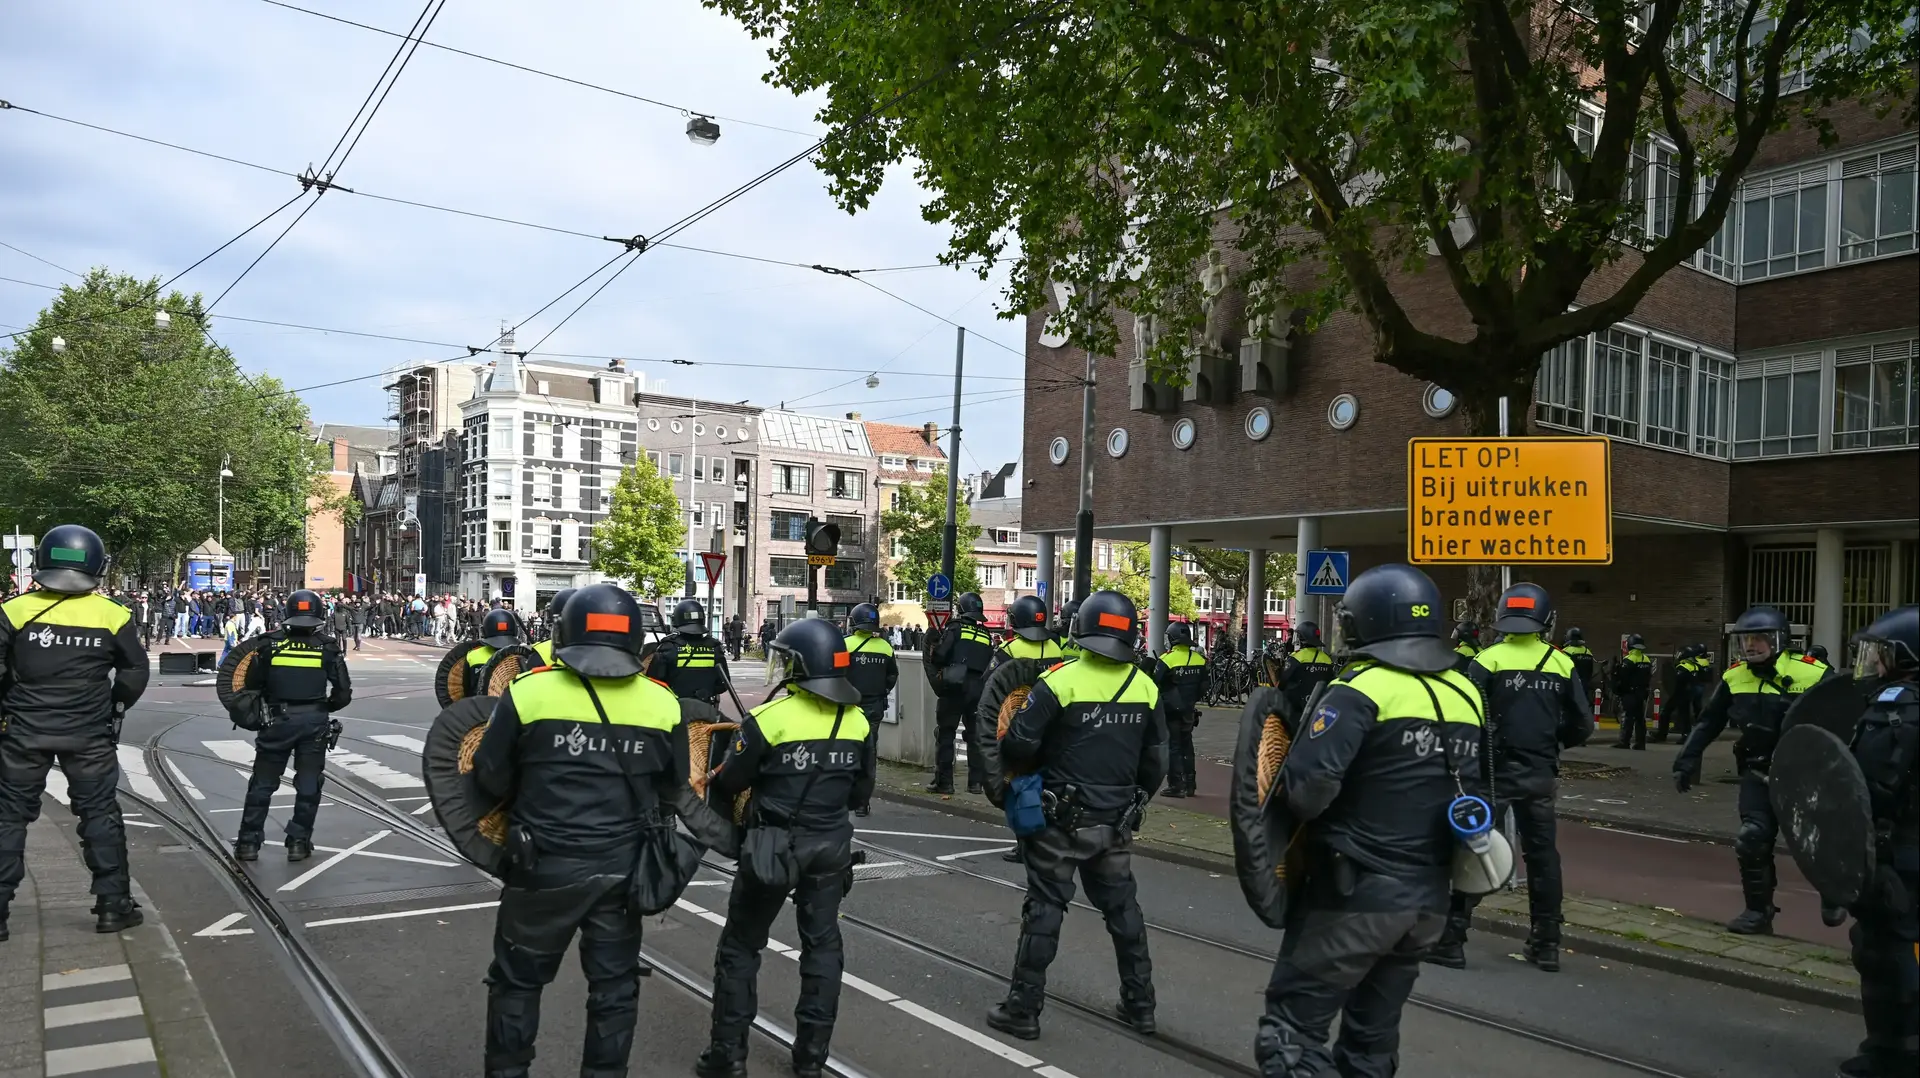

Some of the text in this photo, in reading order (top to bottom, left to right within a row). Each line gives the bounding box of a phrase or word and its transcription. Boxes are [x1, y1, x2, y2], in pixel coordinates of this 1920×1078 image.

[1422, 447, 1519, 468] LET OP!
[1422, 476, 1588, 504] Bij uitrukken
[1421, 505, 1553, 526] brandweer
[1421, 534, 1471, 555] hier
[1480, 534, 1586, 556] wachten
[1411, 605, 1430, 617] SC
[28, 625, 102, 648] POLITIE
[855, 653, 885, 665] POLITIE
[553, 723, 645, 756] POLIIE
[1401, 725, 1479, 757] POLTIE
[782, 743, 854, 770] POLTIE
